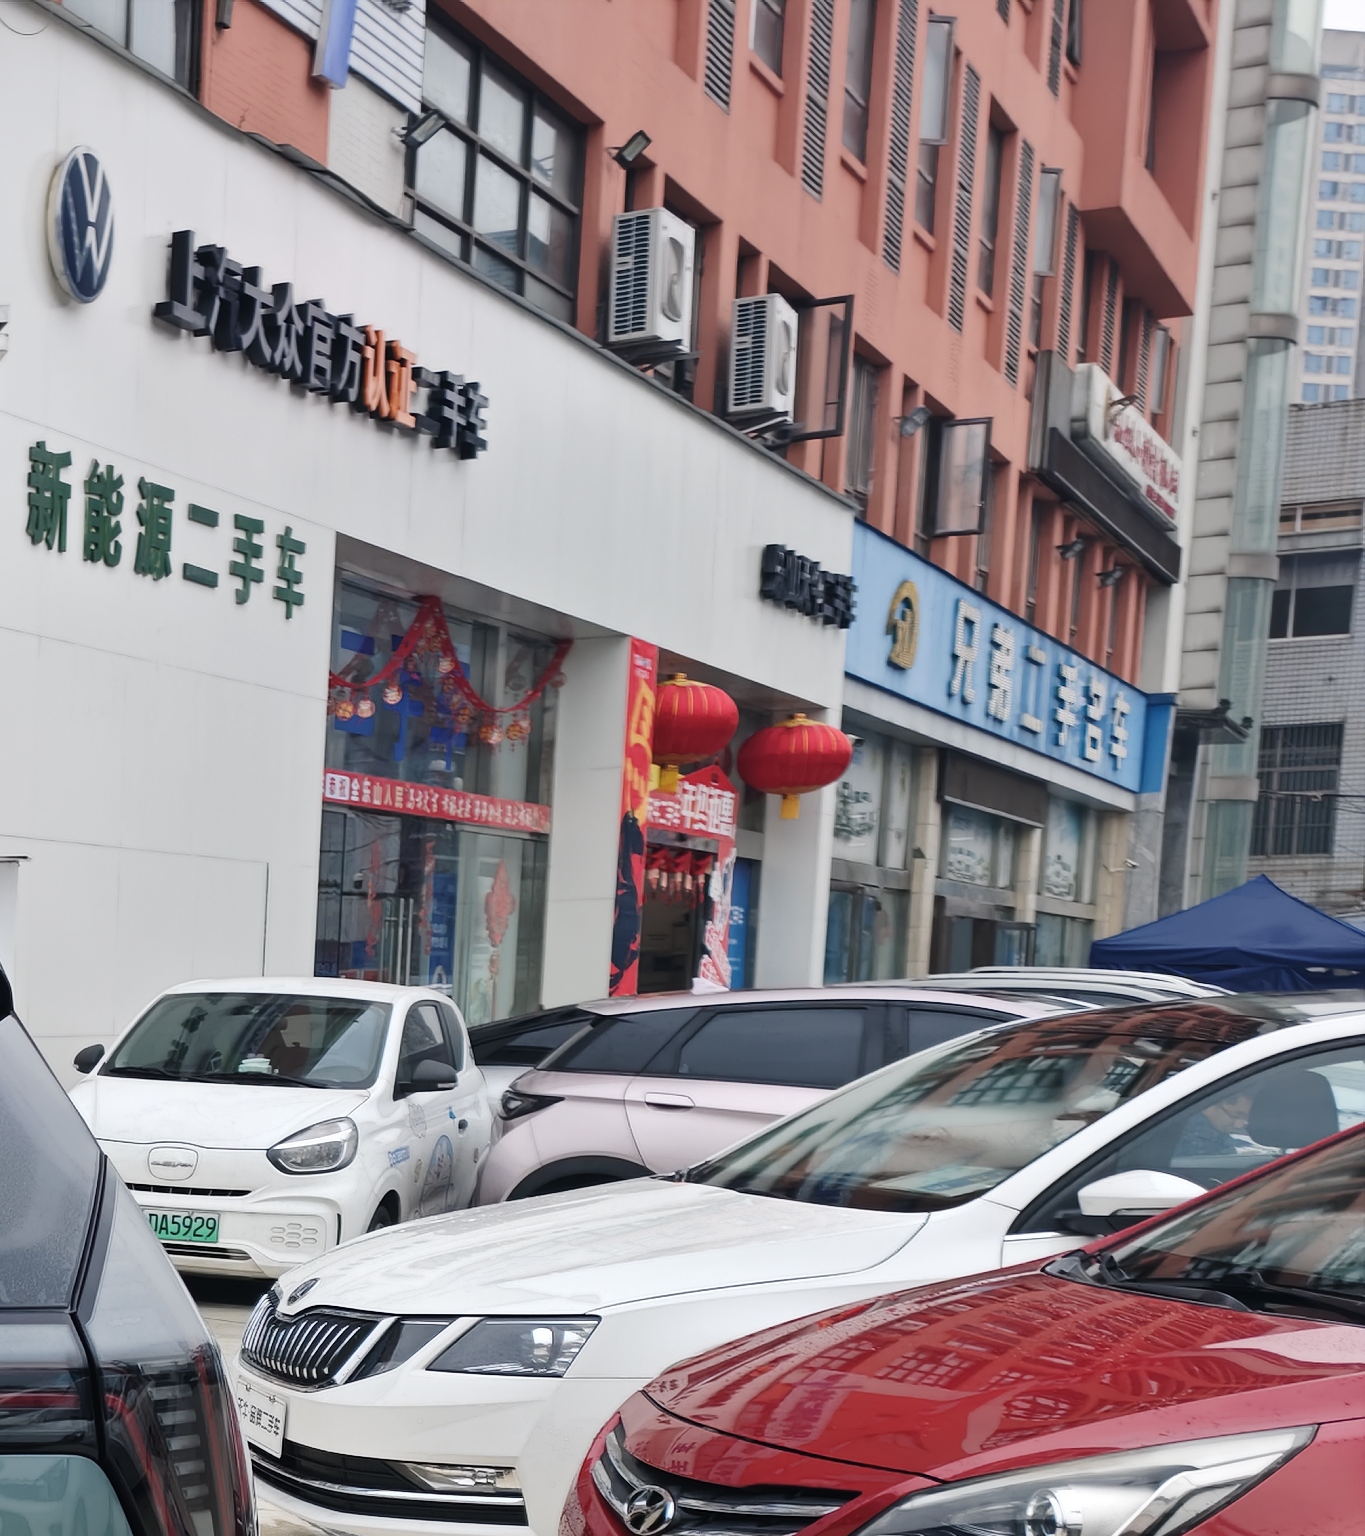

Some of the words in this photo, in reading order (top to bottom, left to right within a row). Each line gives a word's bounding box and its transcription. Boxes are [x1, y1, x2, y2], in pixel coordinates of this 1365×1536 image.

[25, 441, 307, 620] 新能源二手车
